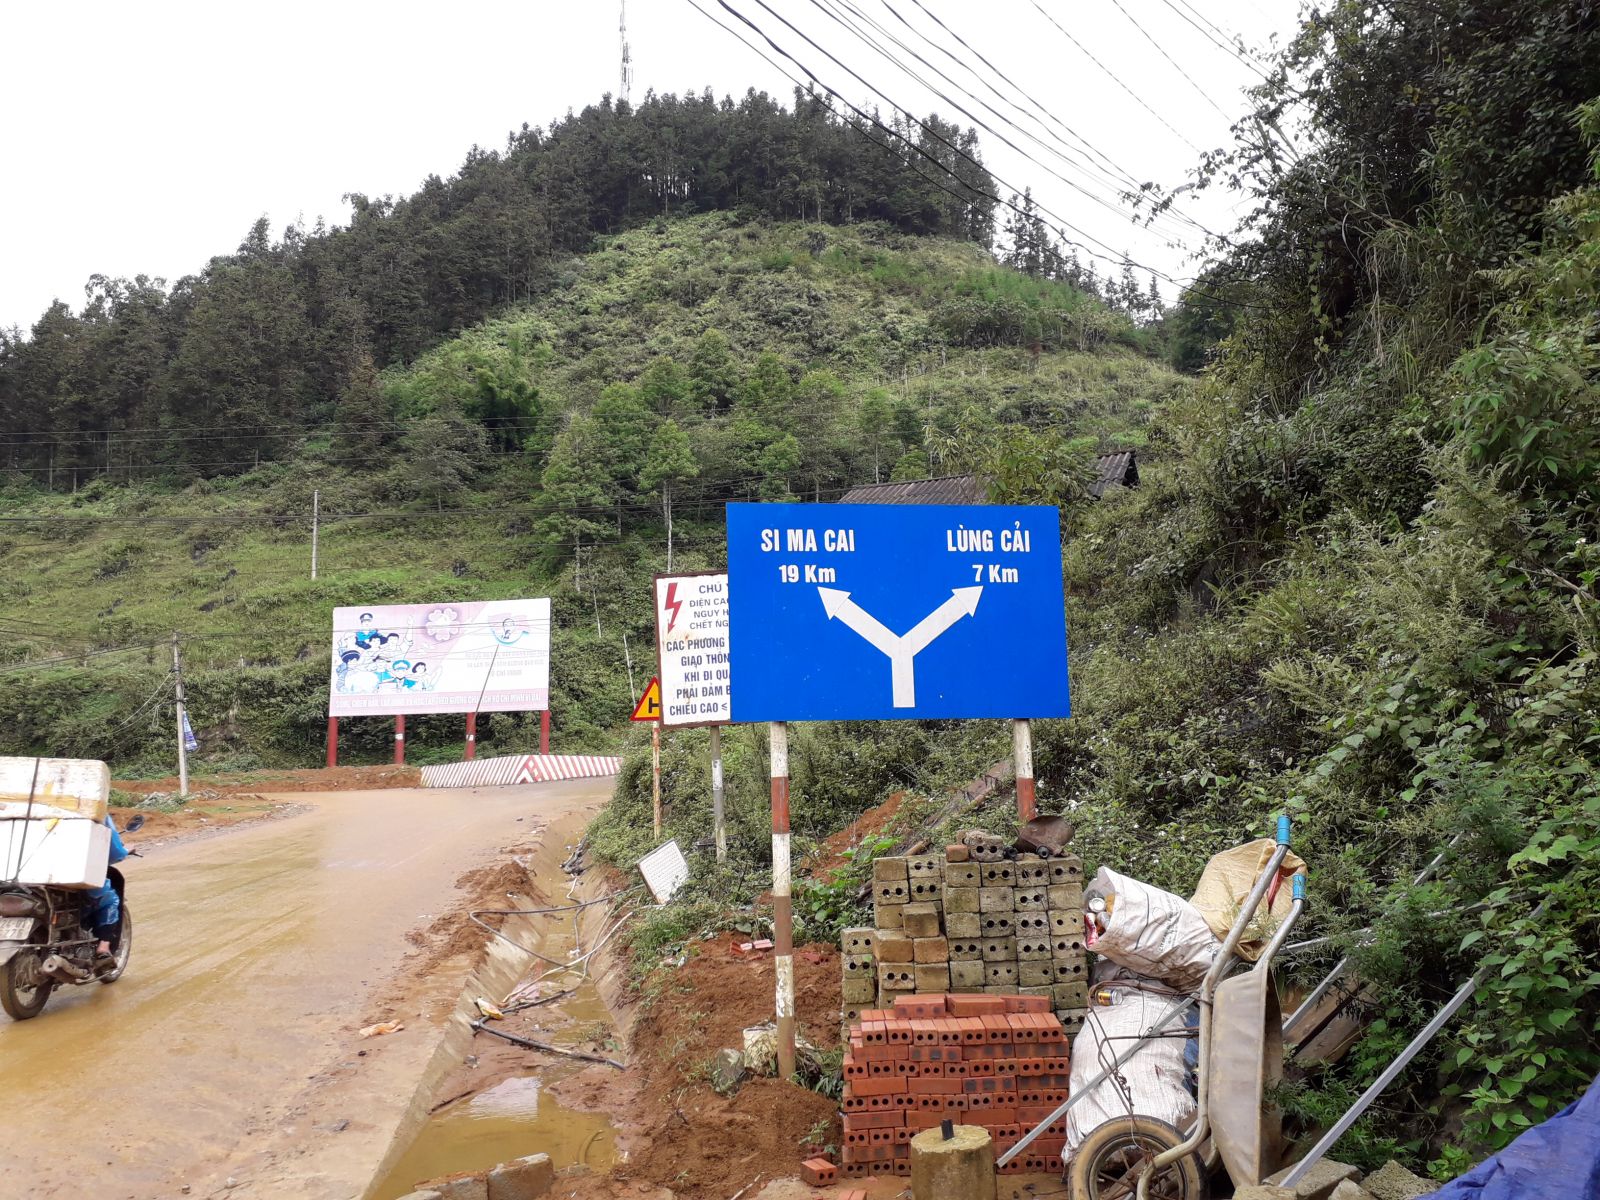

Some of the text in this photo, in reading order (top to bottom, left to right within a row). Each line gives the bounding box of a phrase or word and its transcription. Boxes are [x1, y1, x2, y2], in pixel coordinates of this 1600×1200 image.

[761, 528, 856, 552] SI MA CAI
[947, 521, 1031, 552] LÙNG CẢI
[778, 564, 836, 583] 19 Km
[972, 564, 1019, 583] 7 Km
[693, 609, 720, 619] NGUY
[684, 669, 730, 682] KHI ĐI QU
[700, 702, 719, 713] CAO
